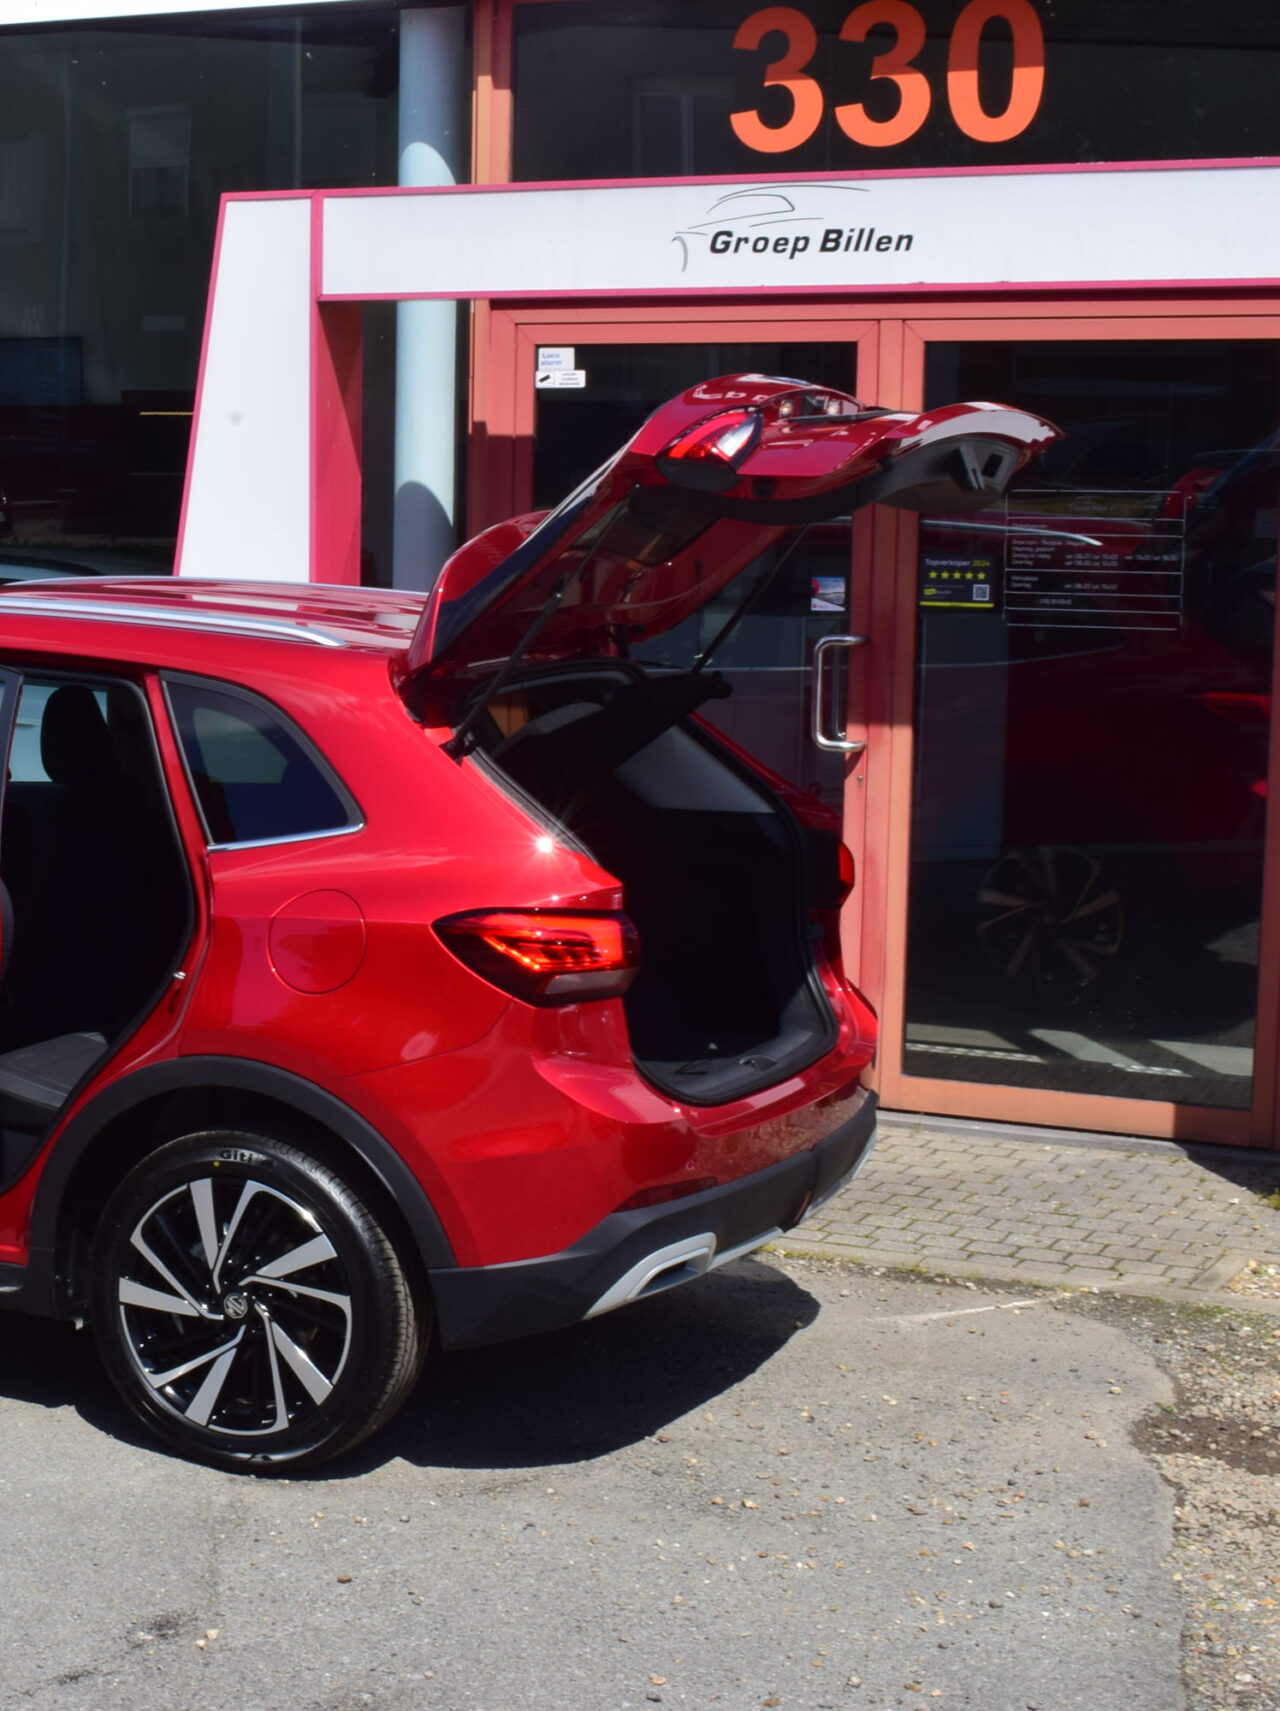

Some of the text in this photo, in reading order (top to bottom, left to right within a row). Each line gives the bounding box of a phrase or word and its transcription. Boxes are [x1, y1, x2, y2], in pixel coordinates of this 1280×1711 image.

[729, 0, 1045, 153] 330
[709, 228, 914, 260] Groep Billen
[924, 558, 971, 568] Topverkoper
[220, 1149, 253, 1163] Giti
